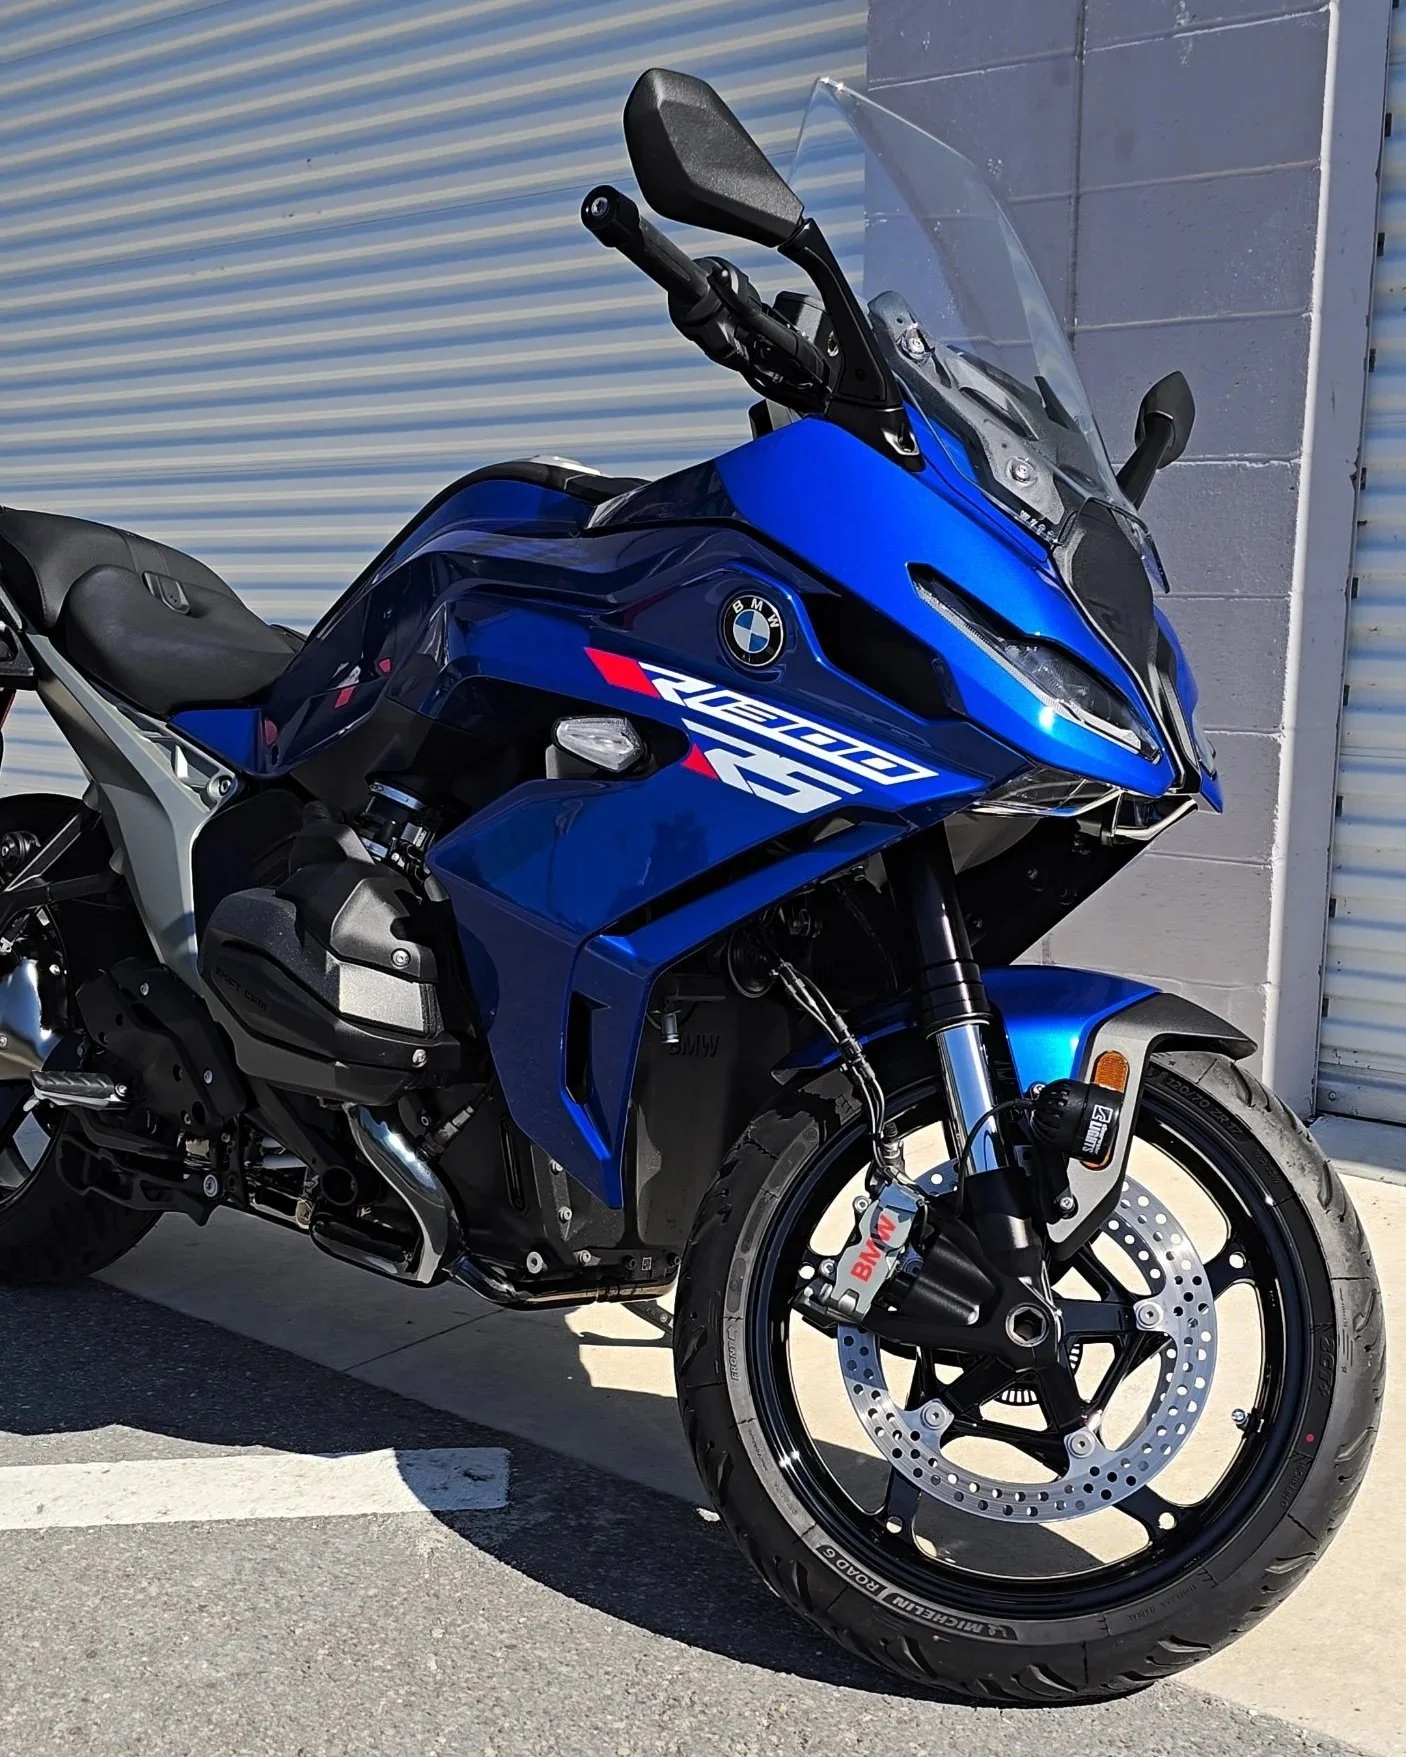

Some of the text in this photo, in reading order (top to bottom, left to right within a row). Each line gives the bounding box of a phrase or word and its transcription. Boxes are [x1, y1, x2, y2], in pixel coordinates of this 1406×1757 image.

[732, 598, 780, 628] BMW
[682, 718, 863, 813] RS
[1208, 1104, 1227, 1123] ZR
[1082, 1120, 1103, 1153] LIGHTS
[850, 1213, 896, 1282] BMW
[728, 1341, 740, 1381] FRONT
[823, 1547, 880, 1593] ROAD 6
[892, 1596, 985, 1634] MICHELIN
